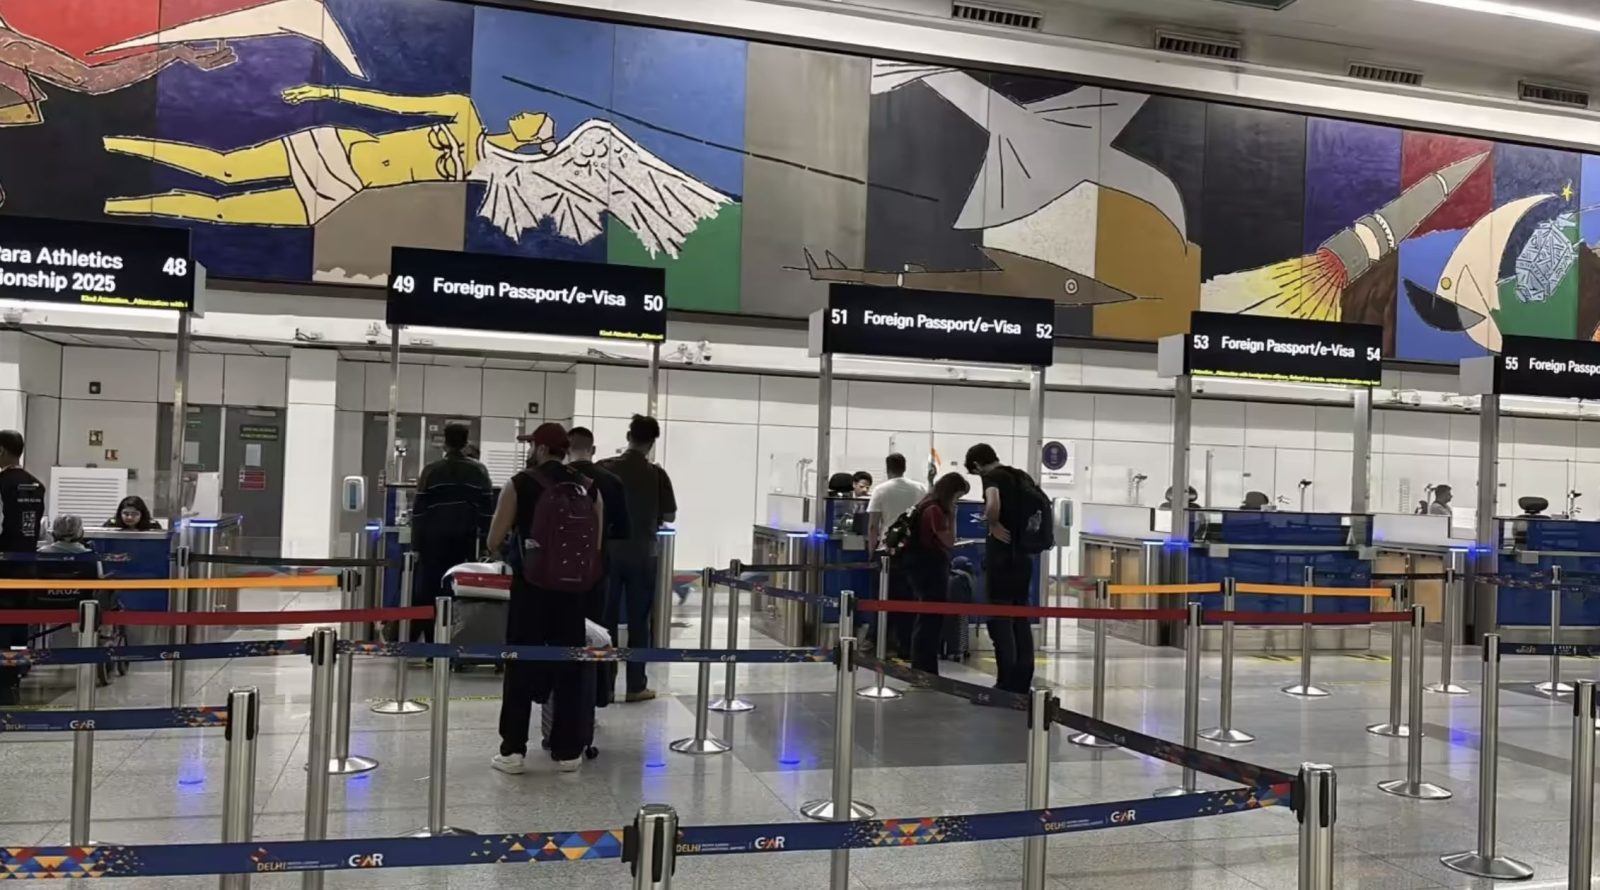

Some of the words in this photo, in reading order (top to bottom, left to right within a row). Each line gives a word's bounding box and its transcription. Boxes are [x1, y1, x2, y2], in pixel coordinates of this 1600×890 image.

[0, 246, 32, 263] ara
[36, 246, 124, 270] Athletics
[162, 257, 187, 276] 48
[72, 273, 116, 292] 2025
[393, 276, 415, 293] 49
[433, 277, 495, 299] Foreign
[499, 281, 626, 307] Passport/e-Visa
[643, 295, 663, 312] 50
[832, 308, 848, 325] 51
[863, 310, 915, 329] Foreign
[917, 314, 1021, 335] Passport/e-Visa
[1036, 323, 1053, 339] 52
[1193, 334, 1209, 350] 53
[1221, 335, 1265, 354] Foreign
[1266, 338, 1355, 358] Passport/e-Visa
[1366, 346, 1381, 362] 54
[1505, 356, 1519, 370] 55
[1529, 357, 1566, 374] Foreign
[256, 861, 287, 872] DELHI
